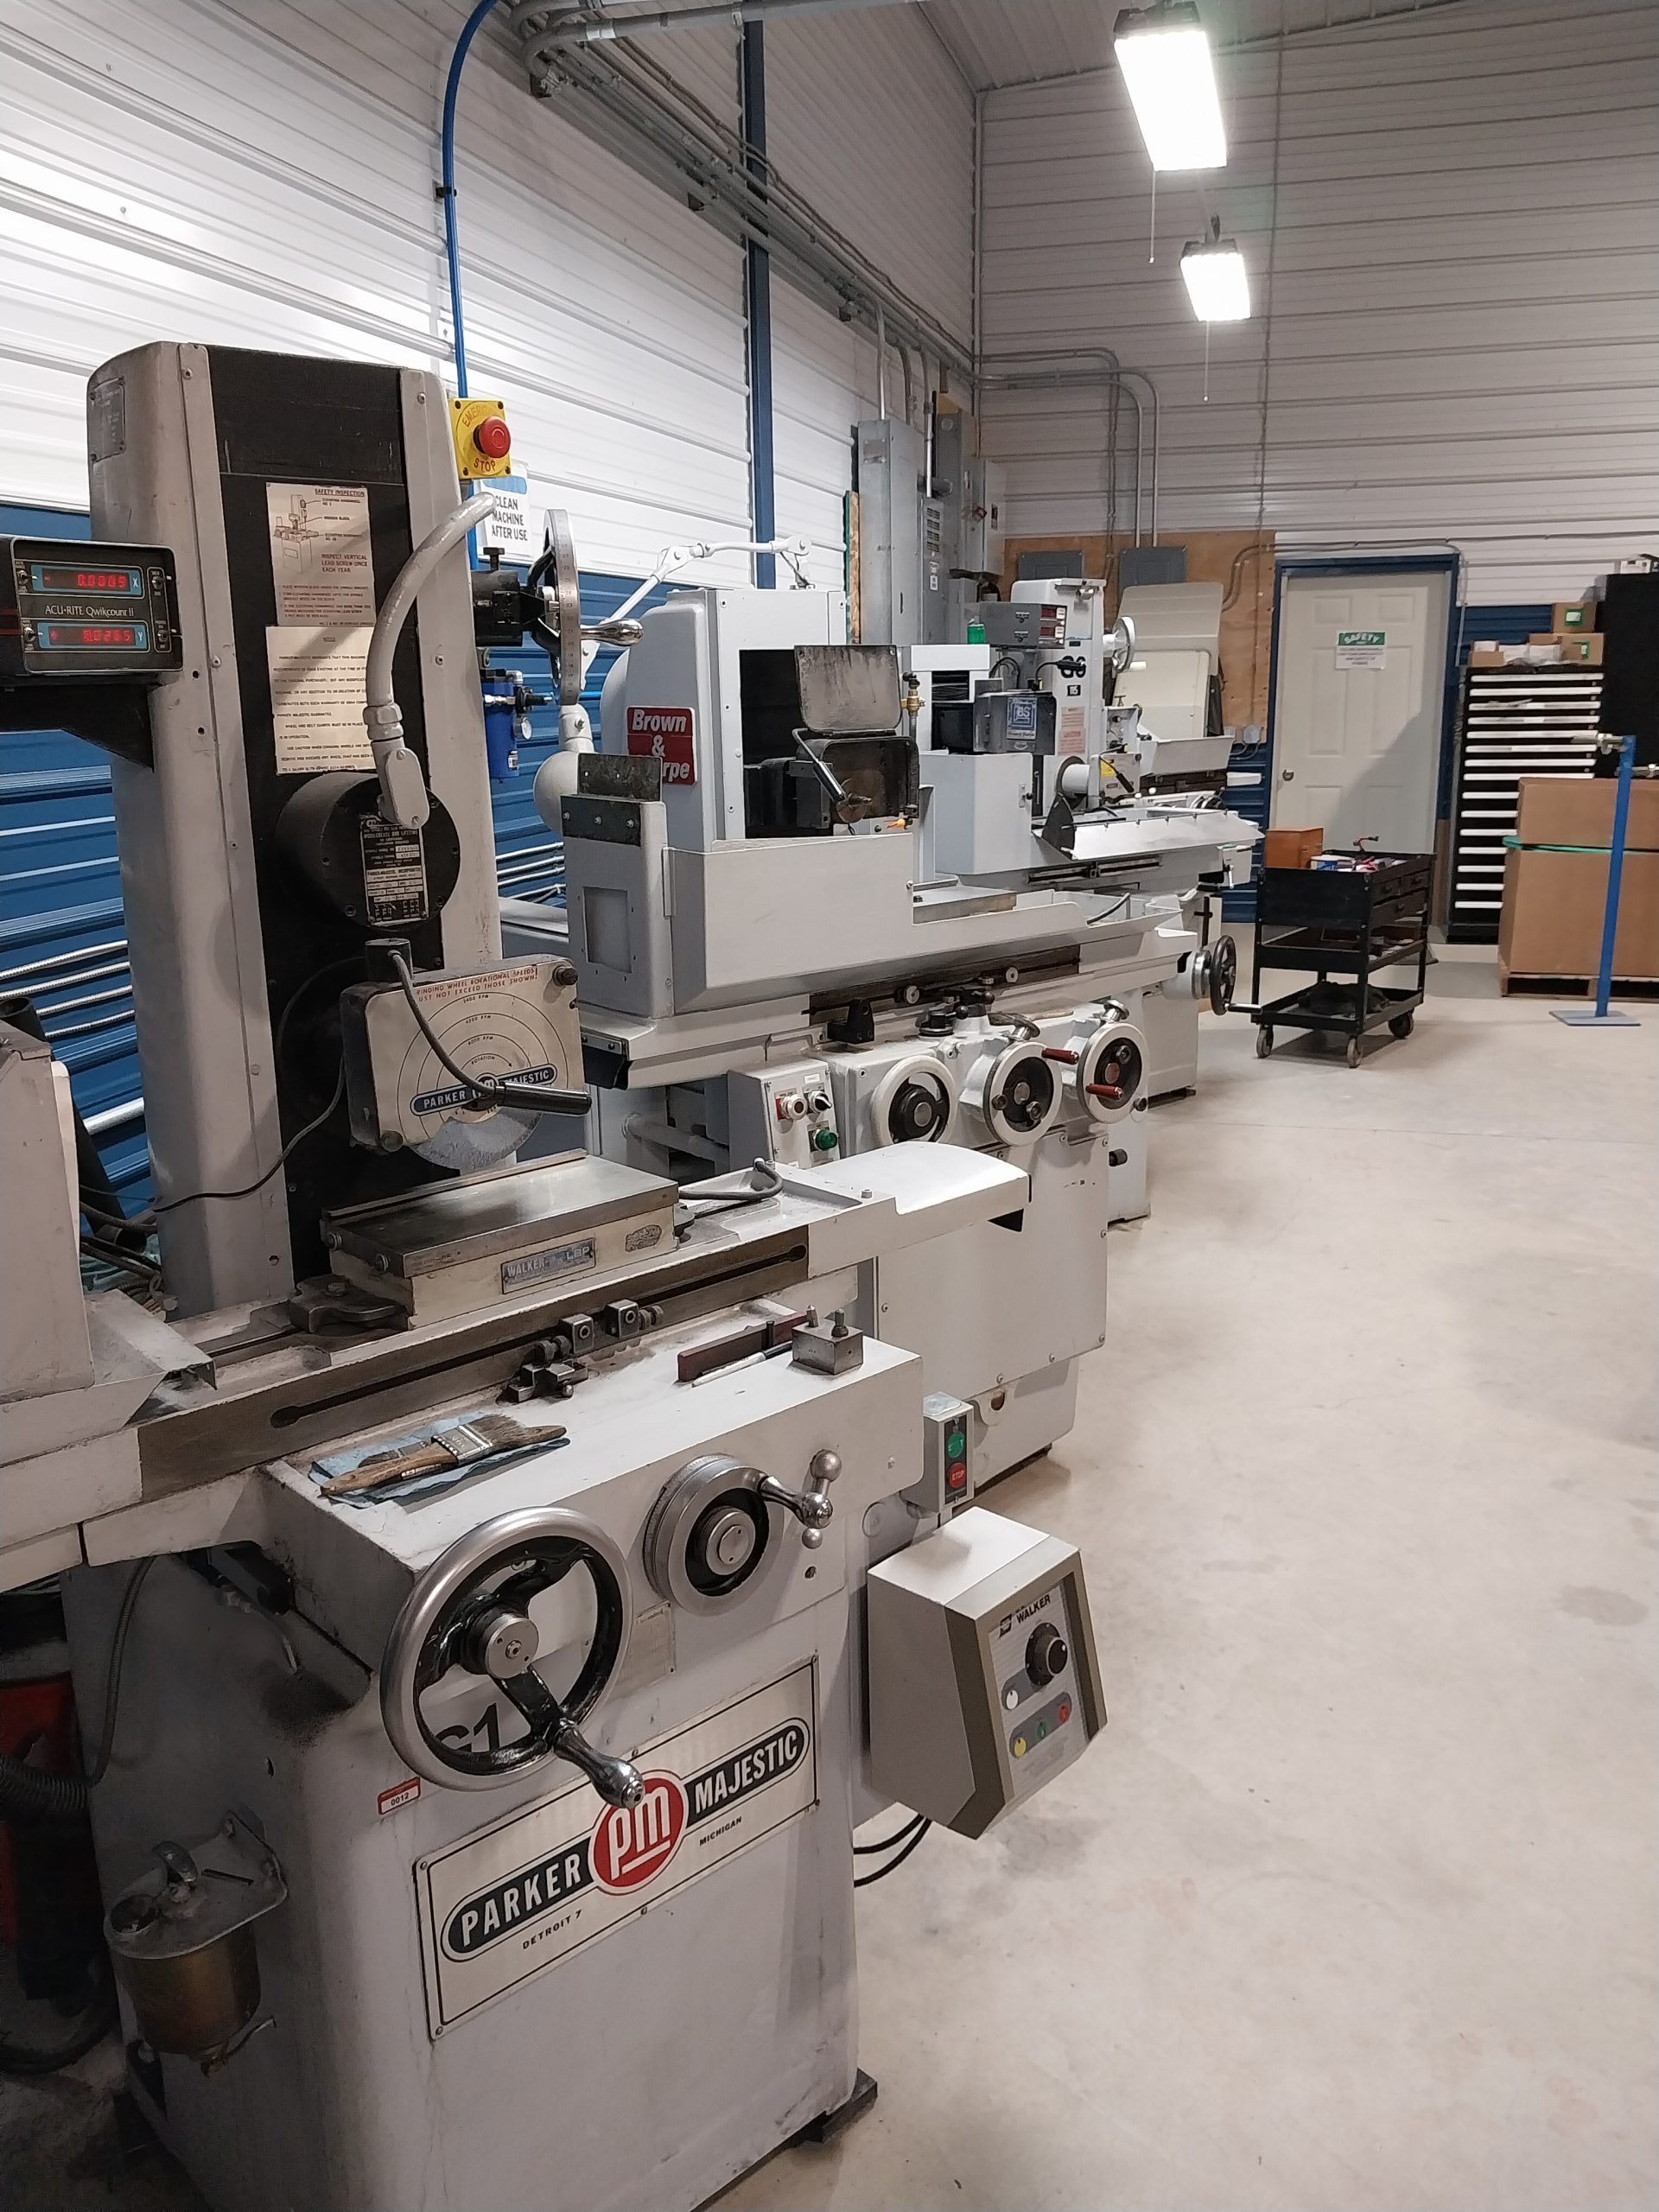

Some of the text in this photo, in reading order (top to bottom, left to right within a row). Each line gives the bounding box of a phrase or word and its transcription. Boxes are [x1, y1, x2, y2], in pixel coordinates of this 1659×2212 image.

[474, 458, 496, 472] STOP
[495, 496, 518, 510] CLEAN
[493, 510, 524, 526] MACHINE
[492, 524, 528, 541] AFTER USE
[132, 577, 139, 588] X
[86, 606, 129, 618] Qwikcount
[138, 632, 143, 641] Y
[632, 709, 687, 733] Brown
[652, 734, 665, 757] &
[662, 762, 690, 782] rpe
[416, 985, 444, 995] RINDING
[447, 981, 467, 989] WHEEL
[471, 973, 510, 985] ROTATIONAL
[419, 993, 433, 1002] UST
[436, 990, 450, 999] NOT
[454, 985, 480, 995] EXCEED
[484, 980, 505, 989] THOSE
[423, 1090, 466, 1109] PARKER
[1016, 1594, 1051, 1624] WALKER
[694, 1730, 798, 1815] MAJESTIC
[391, 1792, 410, 1806] 0012
[699, 1816, 742, 1847] MICHIGAN
[461, 1853, 582, 1948] PARKER
[523, 1909, 582, 1949] DETROIT 7
